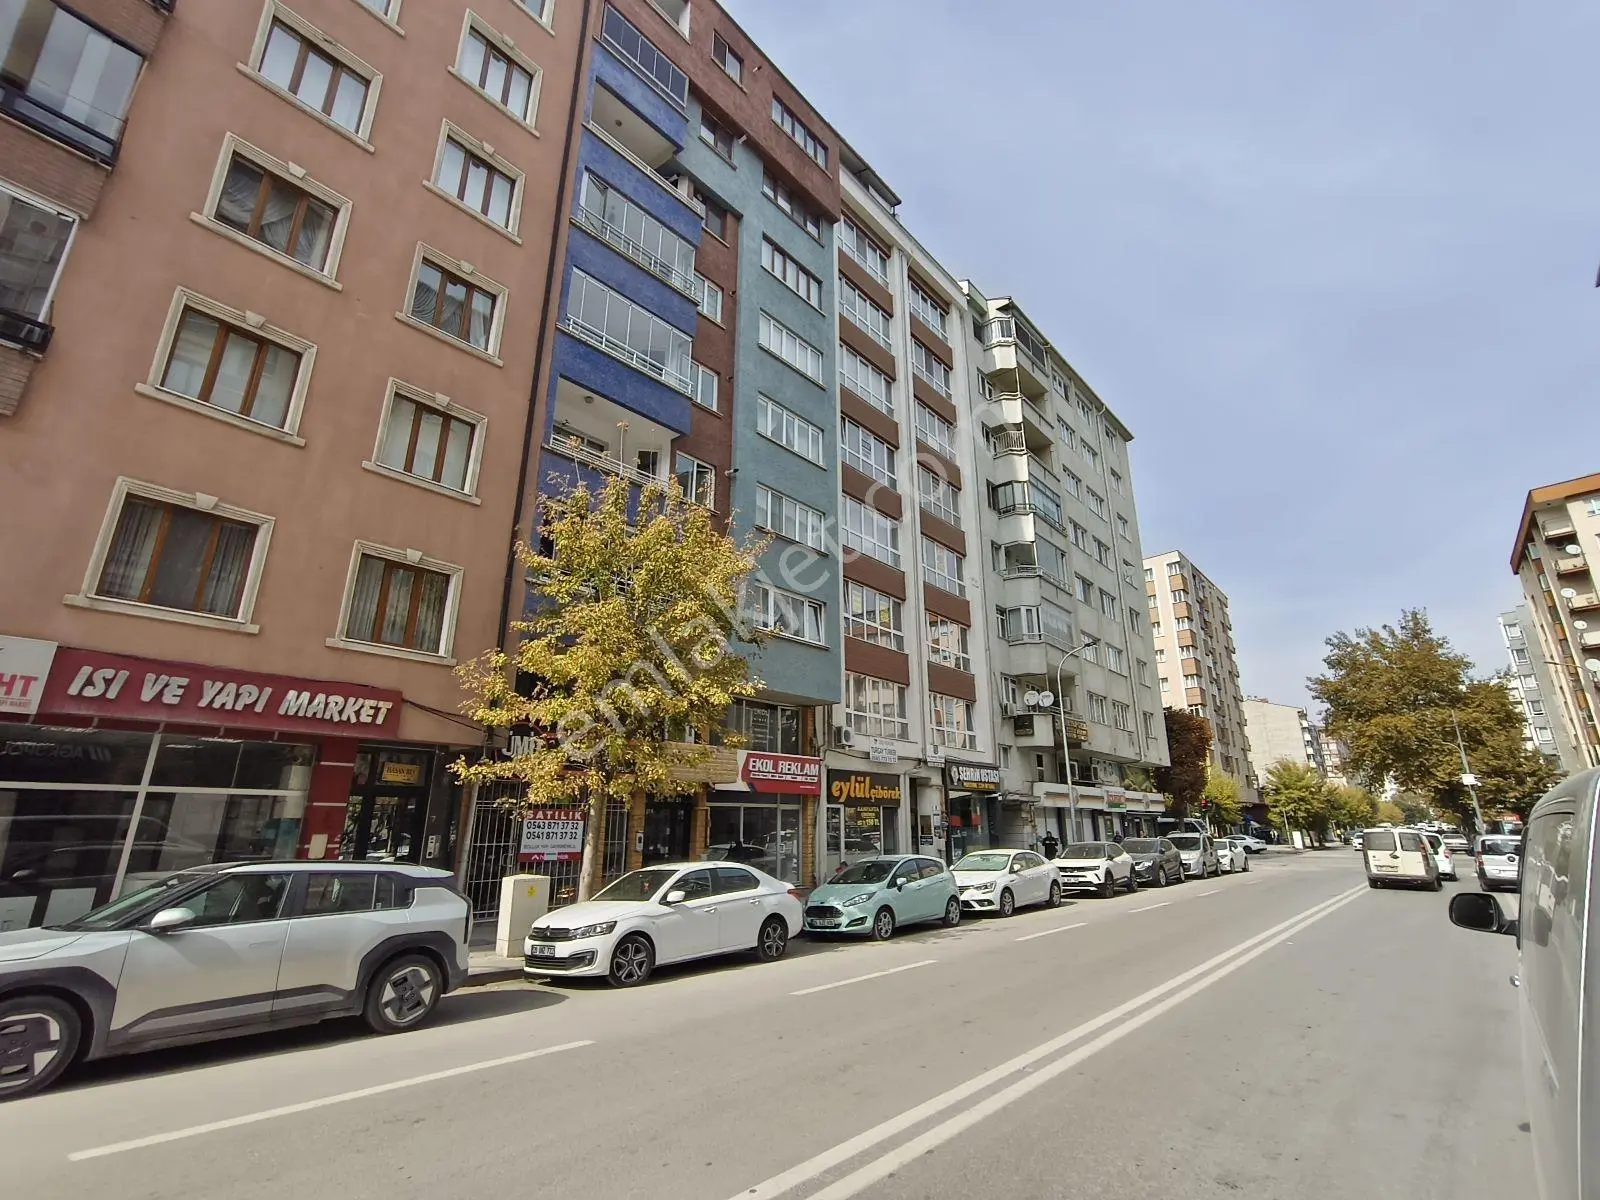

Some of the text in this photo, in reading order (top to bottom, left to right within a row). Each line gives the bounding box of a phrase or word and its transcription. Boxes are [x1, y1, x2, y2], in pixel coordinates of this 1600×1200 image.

[67, 665, 393, 726] ISI VE YAPI MARKET
[749, 758, 820, 776] EKOL REKLAM
[831, 775, 871, 803] eylül
[526, 810, 582, 820] SATILIK
[526, 821, 579, 830] 0543 871 37 32
[526, 831, 578, 840] 0541 871 37 32
